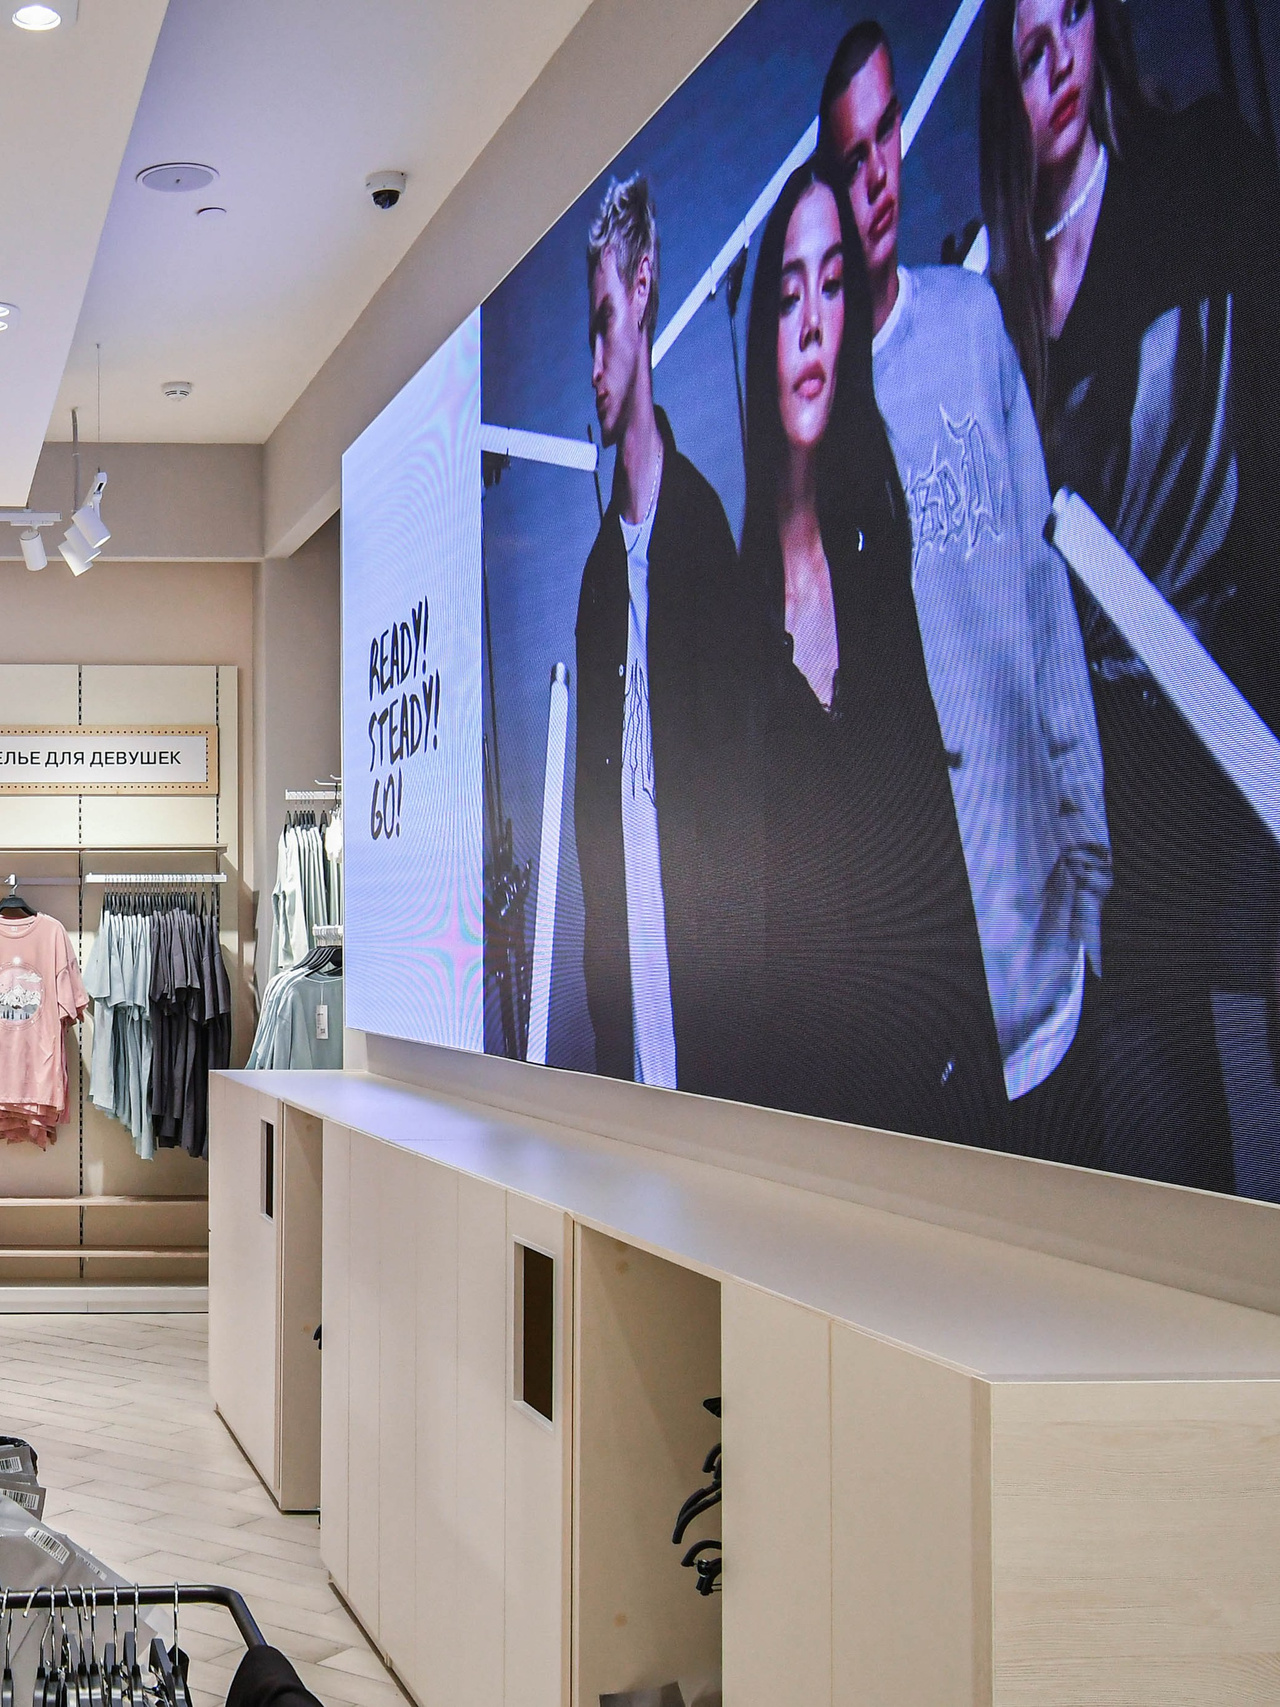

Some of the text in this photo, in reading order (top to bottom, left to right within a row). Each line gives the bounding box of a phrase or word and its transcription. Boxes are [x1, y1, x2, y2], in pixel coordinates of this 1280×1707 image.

[369, 595, 429, 701] READY!
[44, 751, 84, 767] ДЛЯ
[89, 751, 182, 768] ДЕВУШЕК
[368, 669, 440, 772] STEADY!
[371, 767, 403, 841] GO!
